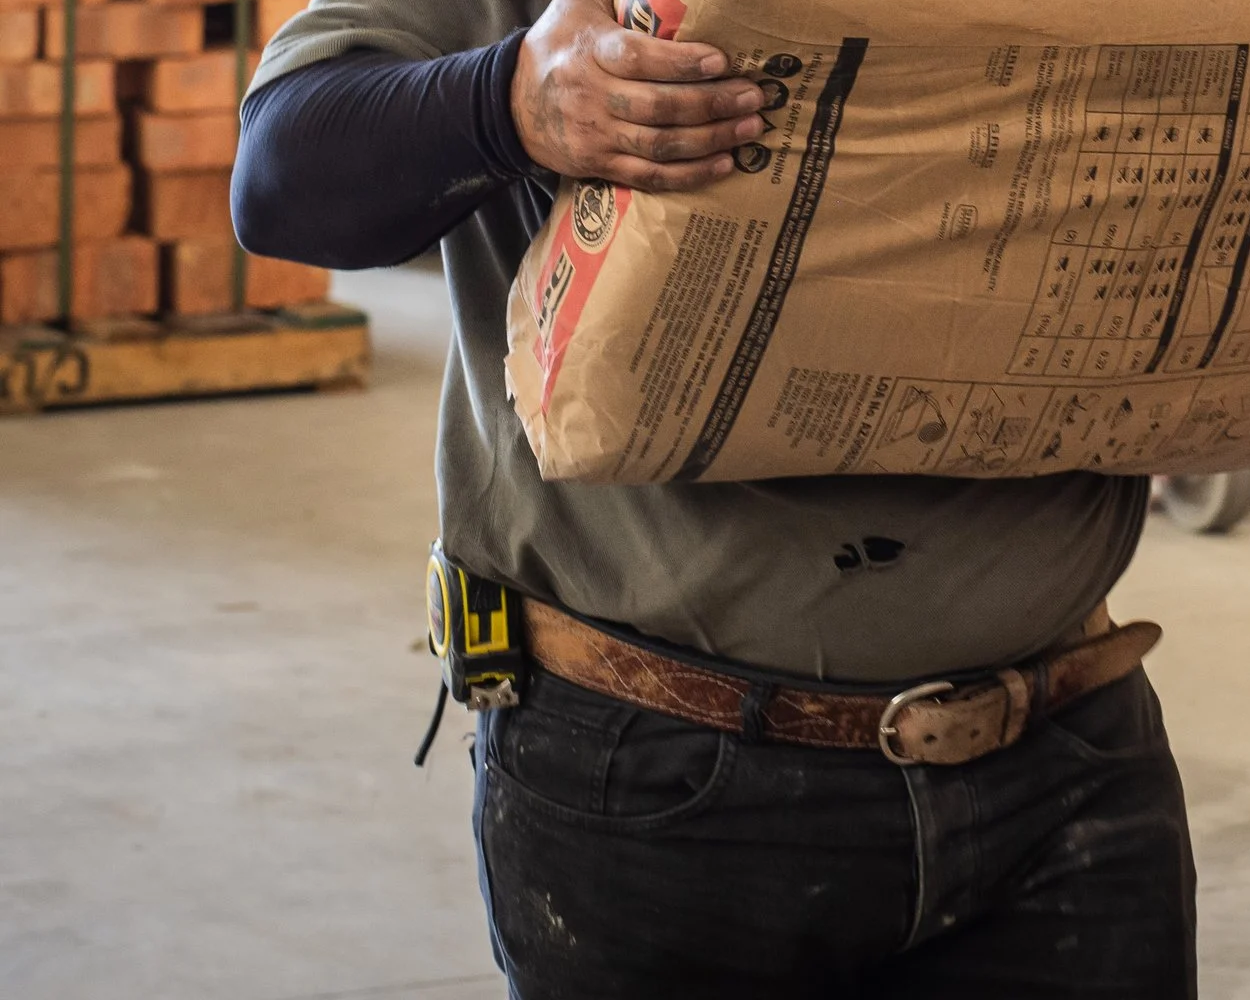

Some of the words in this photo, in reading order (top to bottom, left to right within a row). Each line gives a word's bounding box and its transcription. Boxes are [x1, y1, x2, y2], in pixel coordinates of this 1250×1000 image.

[781, 100, 803, 140] SAFETY
[792, 184, 806, 205] CAN
[805, 170, 822, 200] WHILE
[800, 201, 812, 217] ALL
[729, 241, 750, 278] CEMENT
